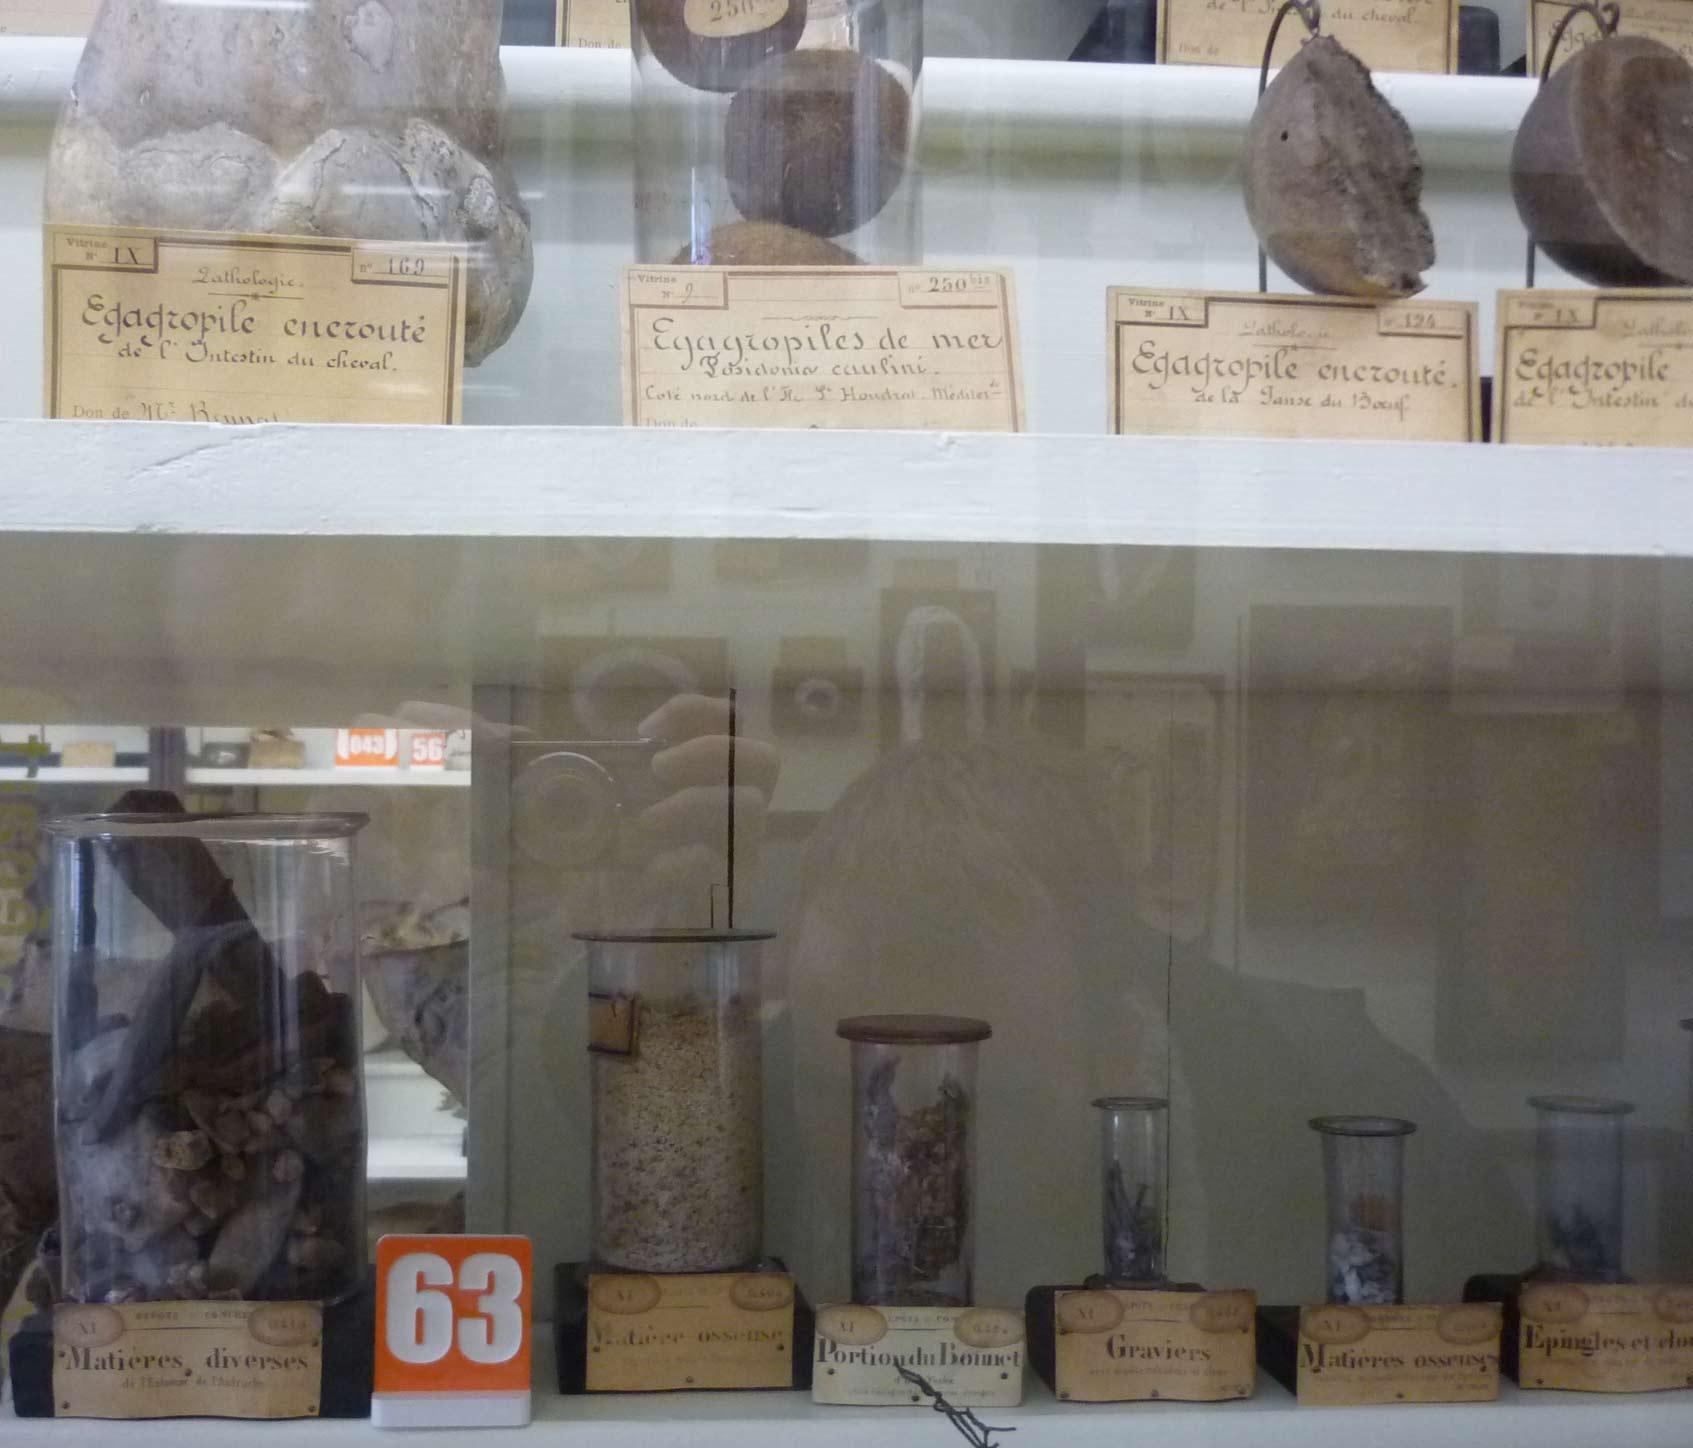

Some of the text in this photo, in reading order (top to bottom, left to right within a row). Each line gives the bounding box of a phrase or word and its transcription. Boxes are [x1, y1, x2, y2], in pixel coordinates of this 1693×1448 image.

[388, 258, 425, 276] 169
[284, 315, 426, 343] encrouté
[879, 328, 909, 350] de
[118, 343, 142, 358] de
[288, 353, 314, 366] du
[73, 405, 103, 418] Don
[112, 407, 130, 419] de
[1321, 394, 1343, 408] du
[386, 1252, 523, 1364] 63
[206, 1347, 309, 1370] diverses
[1106, 1335, 1211, 1361] Graviers
